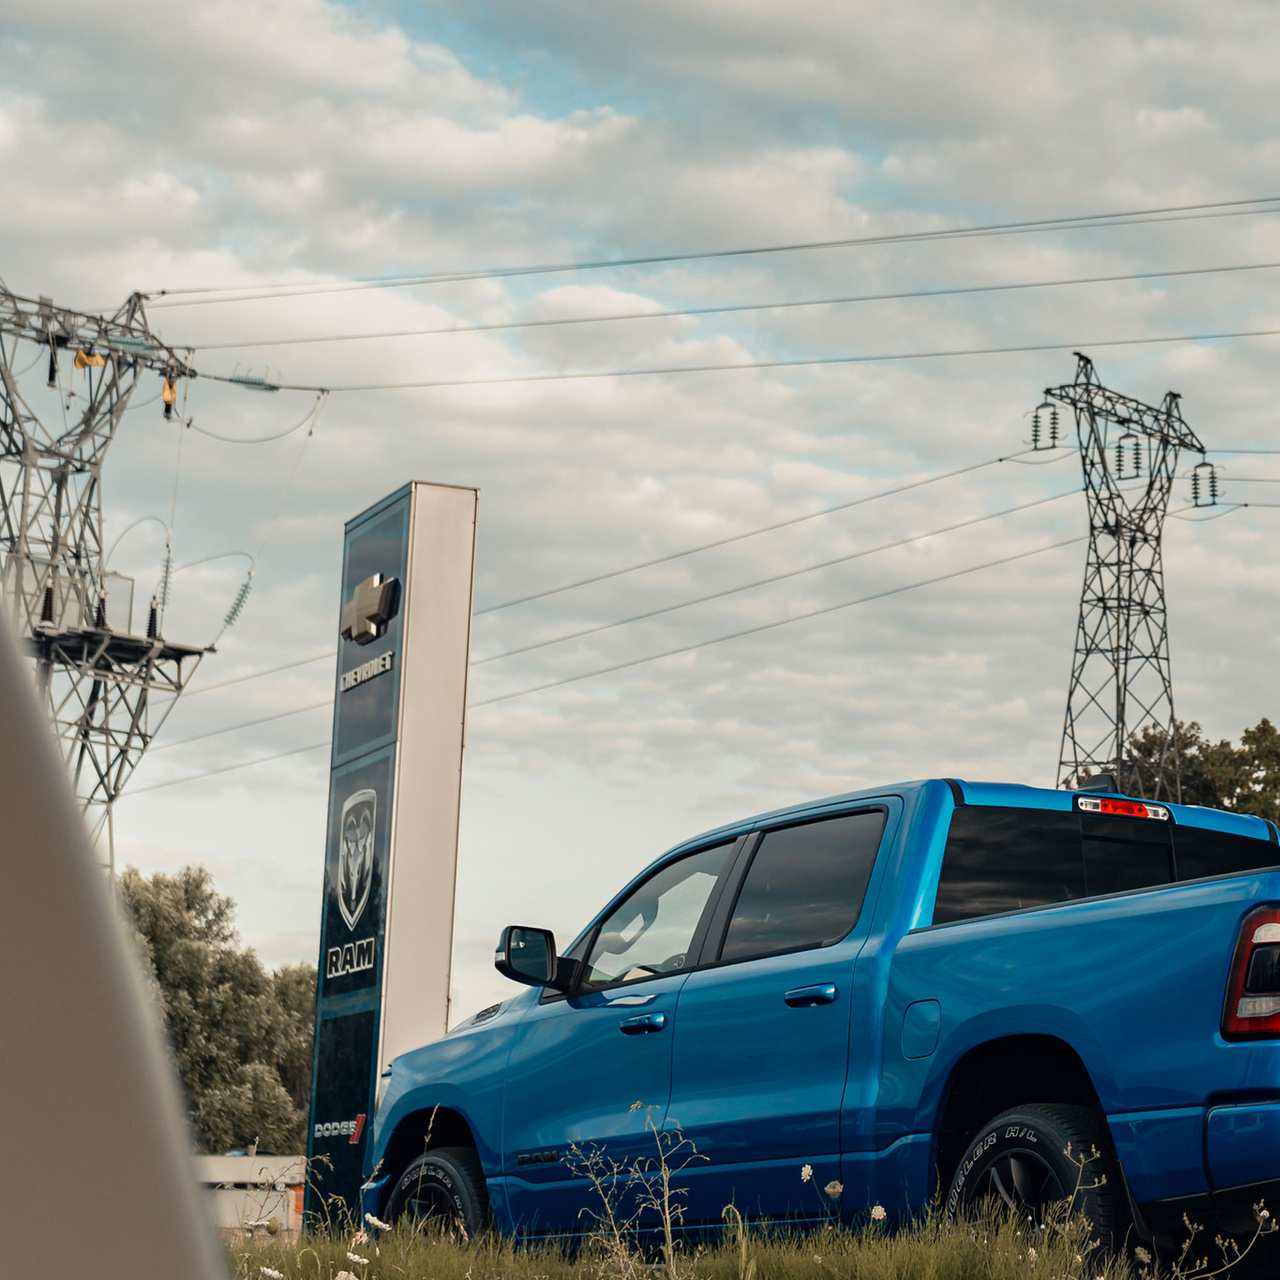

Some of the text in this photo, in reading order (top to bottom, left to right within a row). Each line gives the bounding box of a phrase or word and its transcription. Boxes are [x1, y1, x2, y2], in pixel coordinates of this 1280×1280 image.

[327, 937, 375, 979] RAM
[314, 1120, 357, 1138] DODGE
[517, 1150, 559, 1166] RAM
